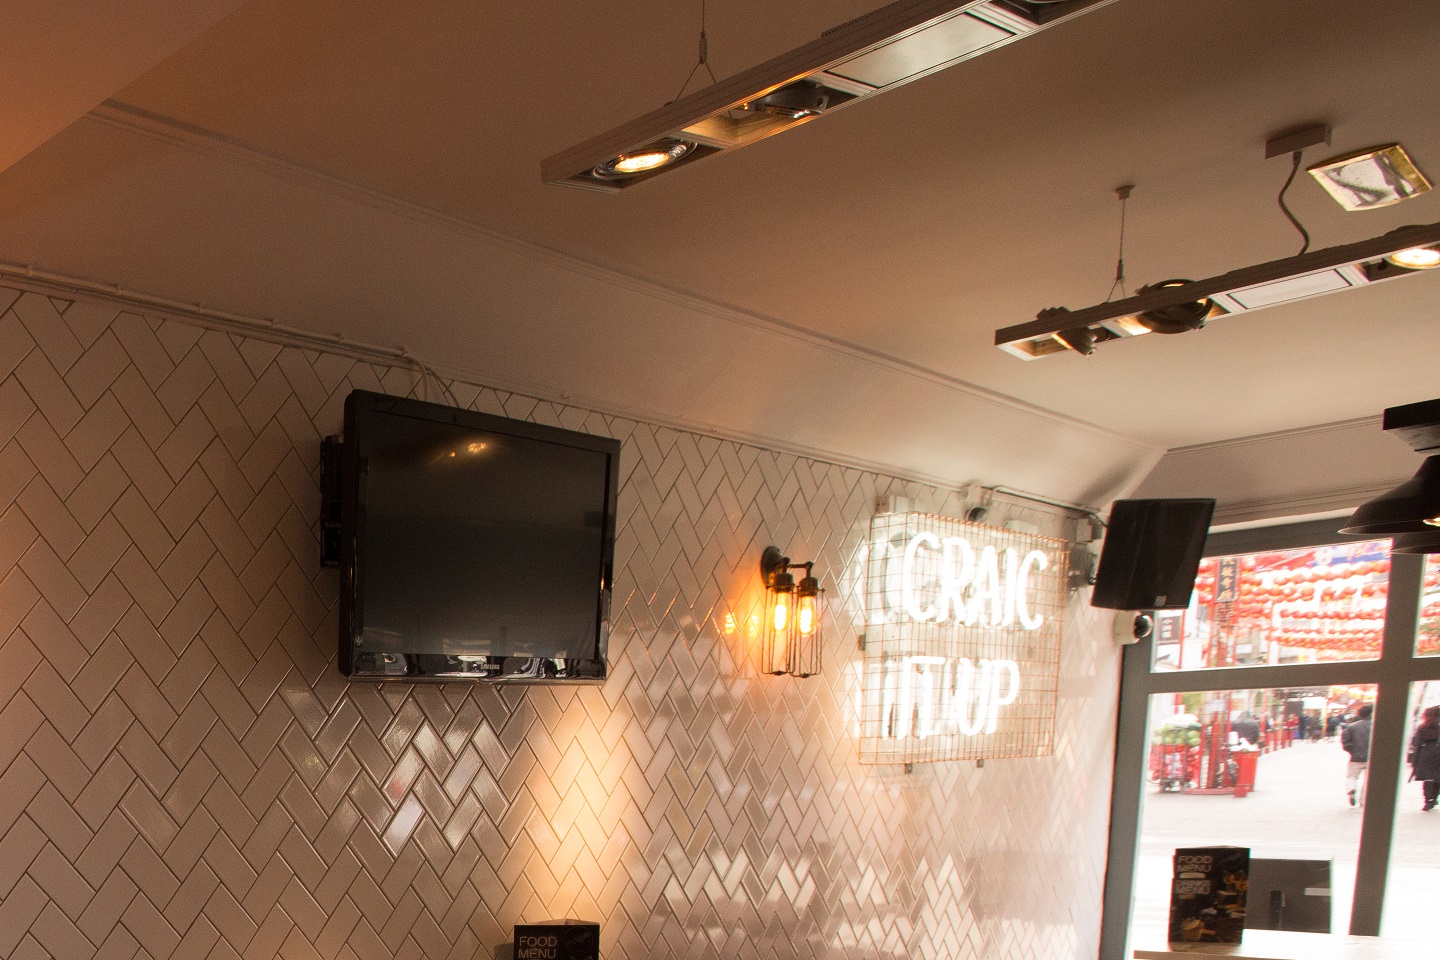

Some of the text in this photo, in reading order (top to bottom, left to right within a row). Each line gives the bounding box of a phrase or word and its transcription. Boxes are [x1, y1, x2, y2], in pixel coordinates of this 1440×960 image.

[902, 532, 1048, 630] CRAIC
[1178, 855, 1212, 864] FOOD
[519, 936, 558, 947] FOOD
[518, 948, 557, 959] MENU
